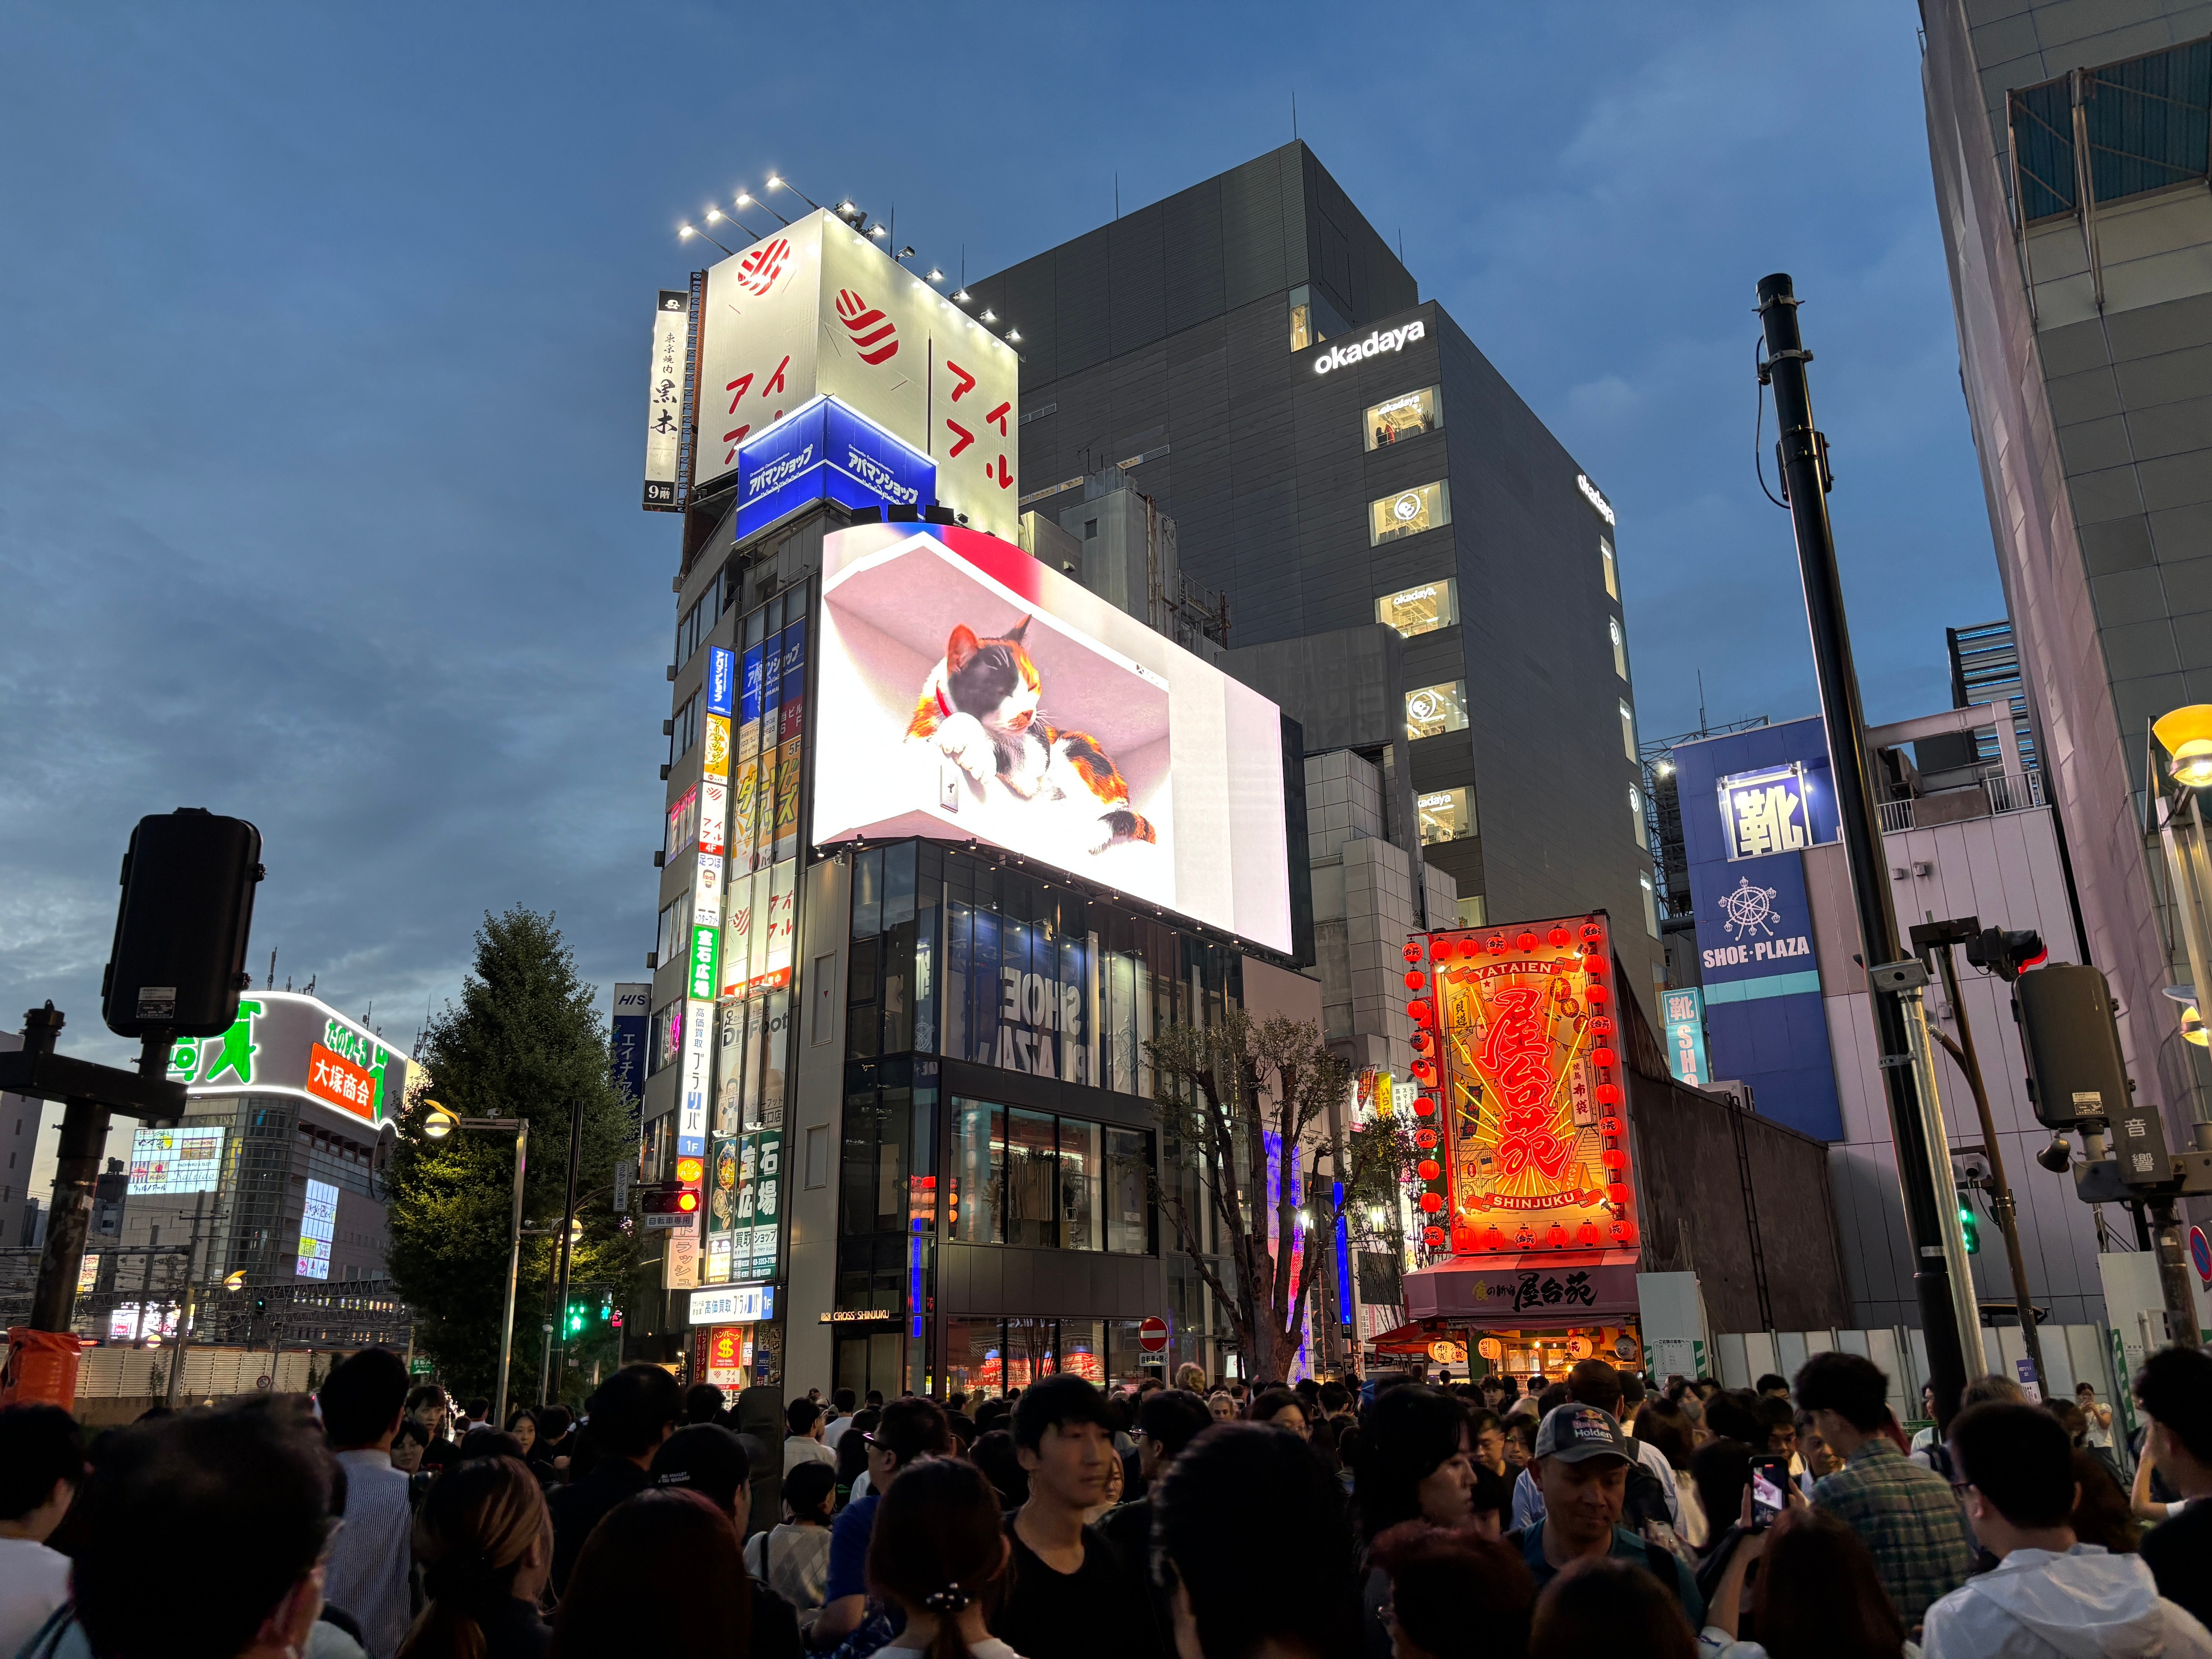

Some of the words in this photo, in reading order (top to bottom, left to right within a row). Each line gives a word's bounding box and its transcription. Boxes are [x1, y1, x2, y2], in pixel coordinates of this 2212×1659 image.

[1315, 321, 1425, 374] okadaya
[651, 379, 678, 434] 黒木
[1383, 396, 1419, 412] okadaya
[749, 443, 813, 496] アパマンショップ
[848, 452, 918, 504] アパマンショップ
[1578, 474, 1615, 526] okadaya
[1394, 587, 1434, 605] okadaya
[781, 704, 802, 722] 当ビル
[788, 739, 801, 756] 5F
[1735, 785, 1803, 856] 靴
[706, 843, 716, 852] 4F
[694, 930, 713, 997] 宝石広場
[1474, 963, 1551, 979] YATAIEN
[618, 994, 646, 1005] HIS
[1669, 996, 1695, 1020] 靴
[326, 1018, 368, 1066] たのめーる
[694, 1008, 704, 1048] 高価買取
[723, 1027, 742, 1047] Dr
[749, 1012, 788, 1040] Foot
[313, 1059, 369, 1107] 大塚商会
[1573, 1083, 1589, 1115] 布袋
[687, 1140, 699, 1153] 1F
[740, 1140, 779, 1180] 宝石
[2124, 1118, 2154, 1172] 音響
[737, 1179, 777, 1219] 広場
[1493, 1192, 1575, 1208] SHINJUKU
[649, 1216, 690, 1224] 自転車専用
[764, 1295, 772, 1310] 1F
[1511, 1271, 1598, 1312] 屋台苑
[833, 1311, 855, 1321] CROSS
[857, 1310, 890, 1320] SHINJUKU
[714, 1330, 740, 1341] ハンバーグ
[1575, 1429, 1613, 1440] Holden
